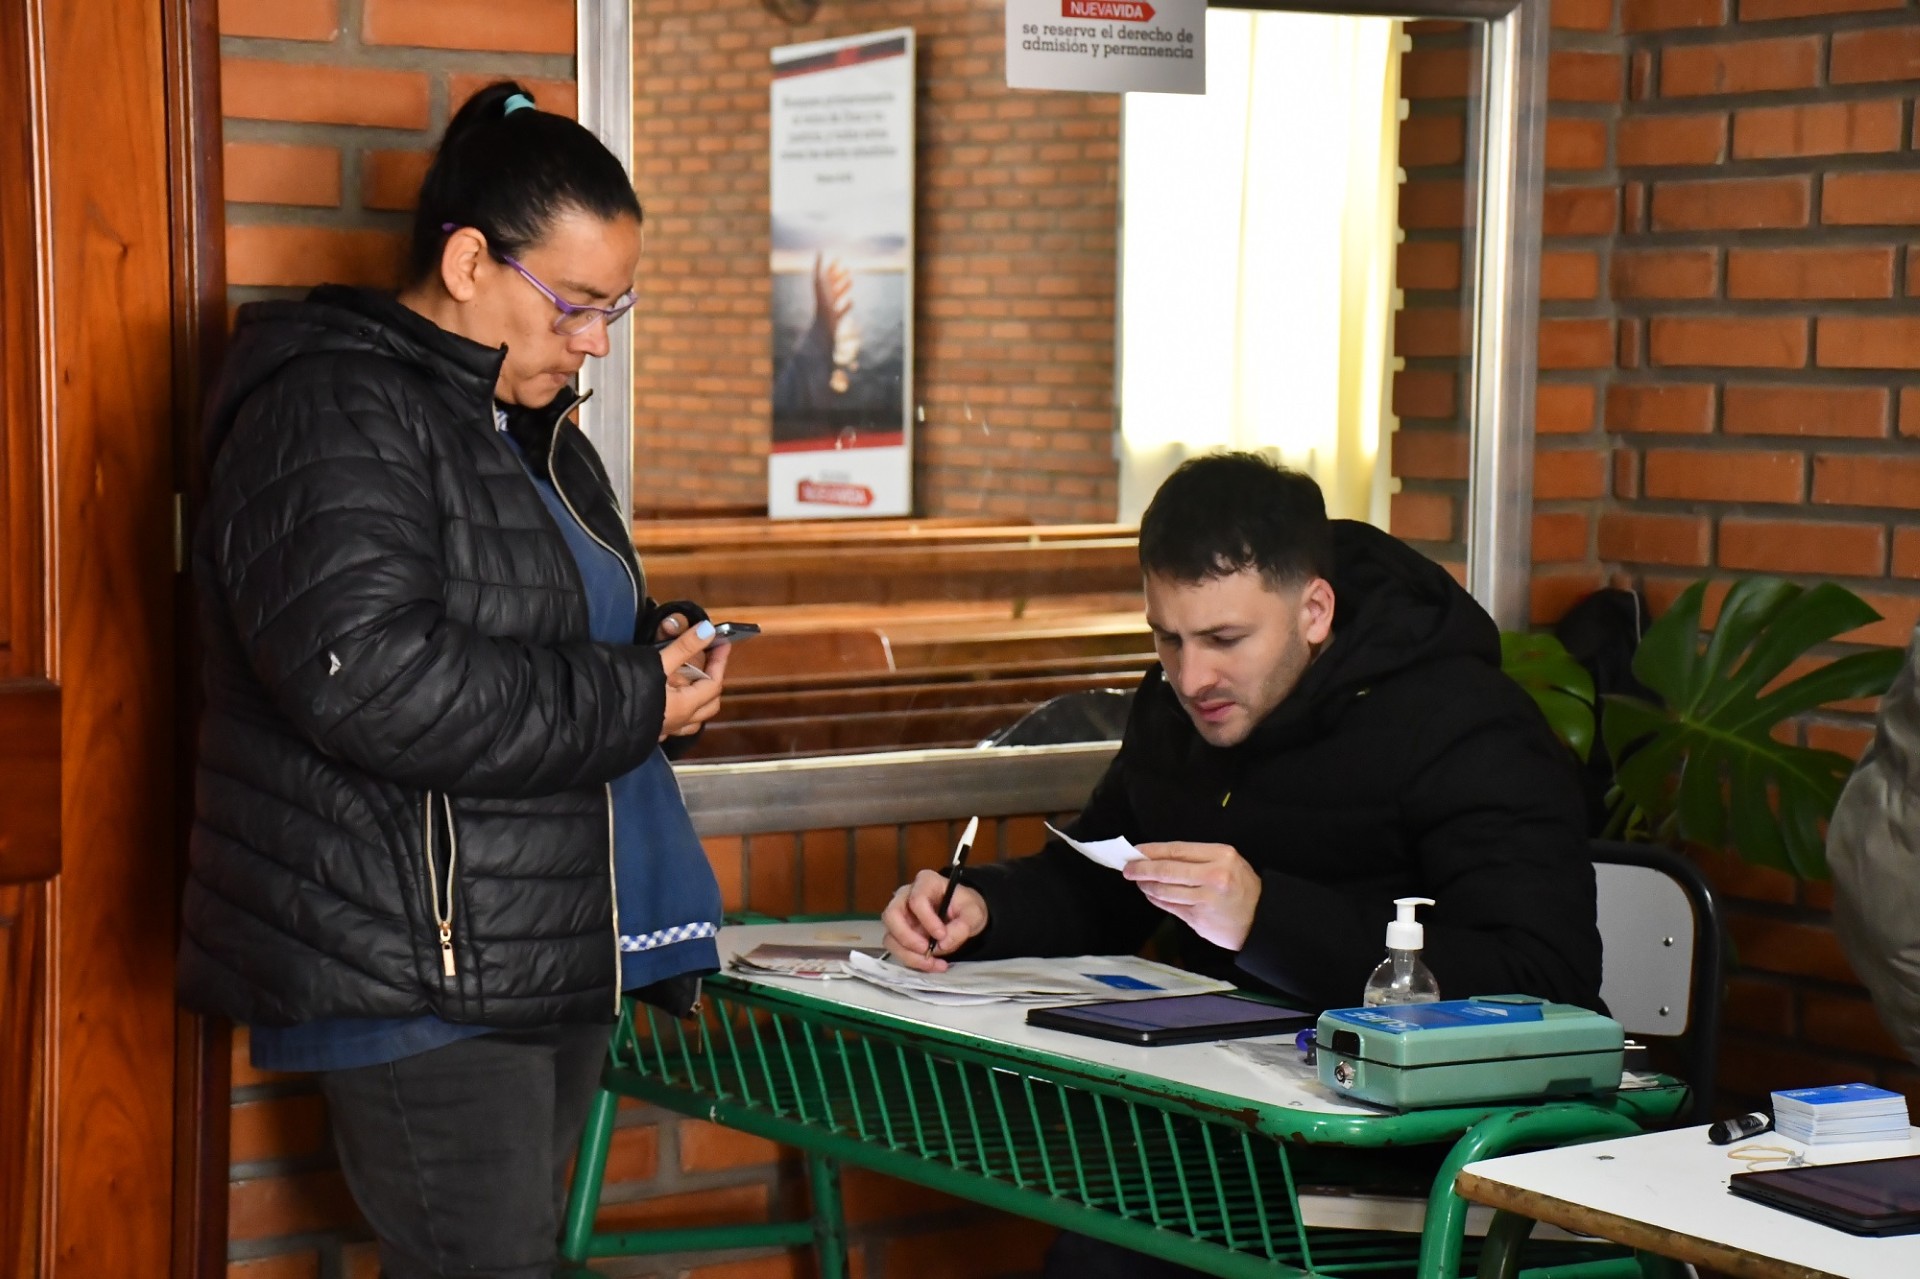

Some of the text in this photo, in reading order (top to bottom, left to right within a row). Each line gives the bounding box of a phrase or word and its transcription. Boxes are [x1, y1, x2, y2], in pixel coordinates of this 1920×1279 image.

[1070, 2, 1144, 18] NUEVAVIDA
[1022, 23, 1194, 43] se reserva el derecho de
[1091, 43, 1100, 58] y
[1104, 44, 1194, 59] permanencia
